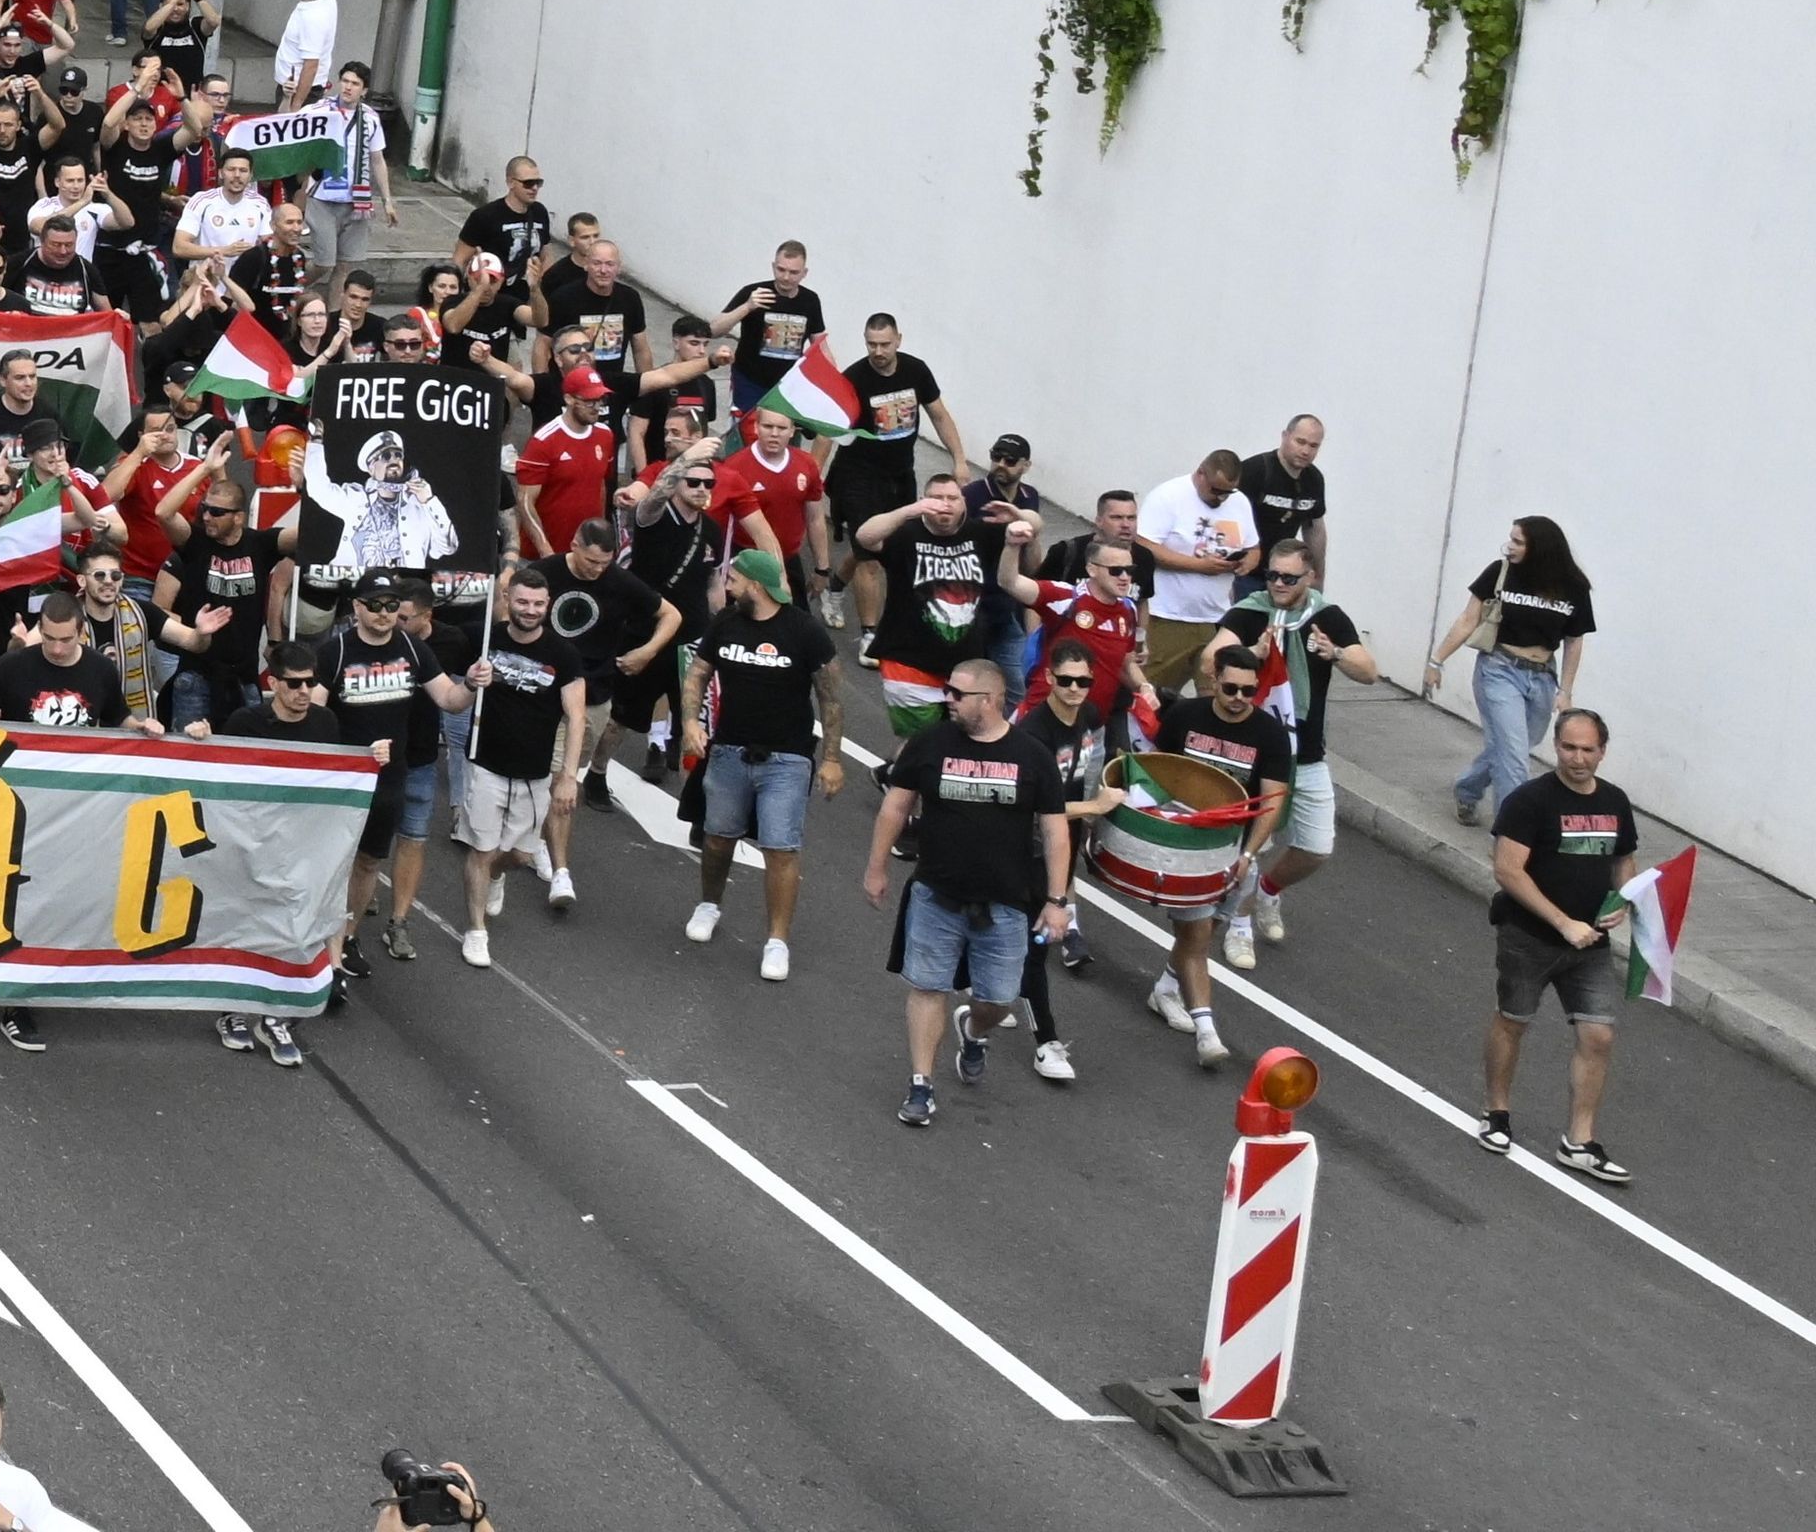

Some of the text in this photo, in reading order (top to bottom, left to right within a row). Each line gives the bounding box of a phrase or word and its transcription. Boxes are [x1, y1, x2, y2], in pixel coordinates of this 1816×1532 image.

[254, 114, 328, 148] GYŐR
[336, 378, 492, 429] FREE GiGi!
[914, 555, 984, 586] LEGENDS
[719, 646, 791, 669] ellesse
